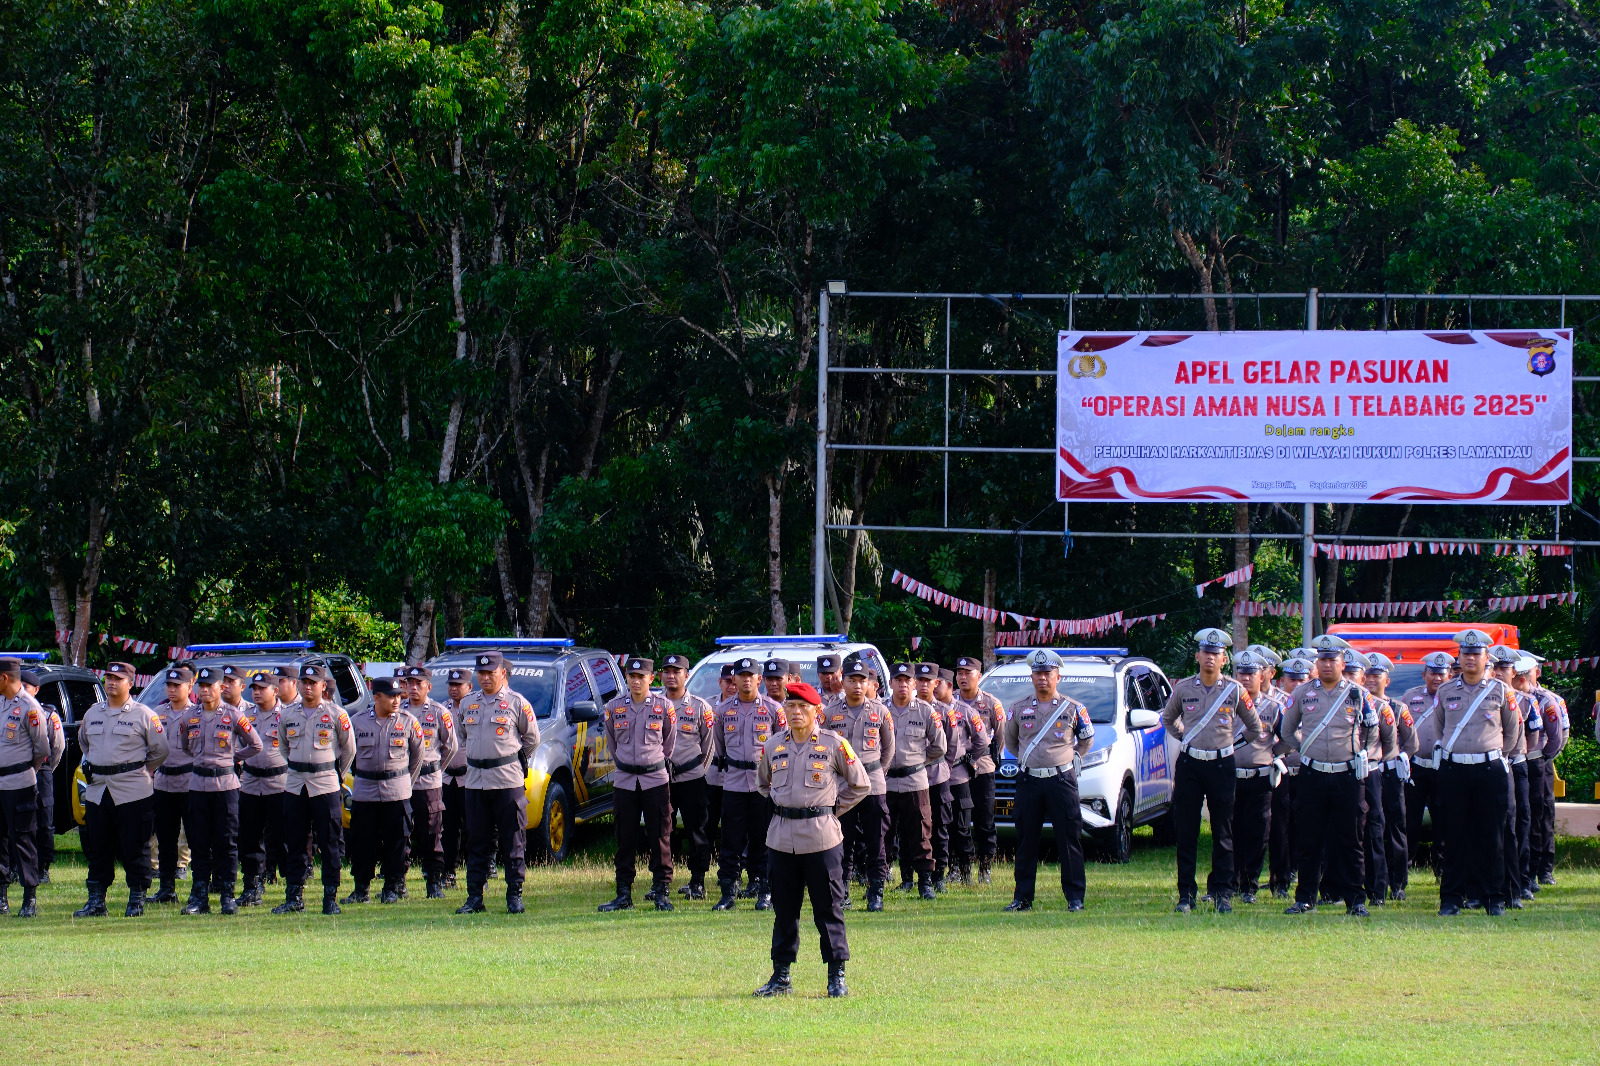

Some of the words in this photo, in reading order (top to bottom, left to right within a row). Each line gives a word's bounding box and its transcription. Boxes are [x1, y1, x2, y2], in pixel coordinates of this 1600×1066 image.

[1175, 360, 1234, 384] APEL
[1243, 360, 1320, 384] GELAR
[1330, 359, 1448, 383] PASUKAN
[1193, 395, 1258, 416] AMAN
[1266, 395, 1326, 416] NUSA
[1335, 395, 1340, 416] I
[1348, 394, 1465, 416] TELABANG
[1265, 424, 1305, 437] Dalam
[1310, 424, 1354, 440] rangka
[1095, 445, 1168, 458] PEMULIHAN
[1171, 445, 1273, 459] HARKAMTIBMAS
[1277, 445, 1290, 459] DI
[1293, 445, 1350, 459] WILAYAH
[1353, 445, 1402, 459] HUKUM
[1405, 445, 1456, 459] POLRES
[1459, 445, 1533, 459] LAMANDAU
[1310, 481, 1349, 490] September
[1350, 481, 1367, 489] 2025
